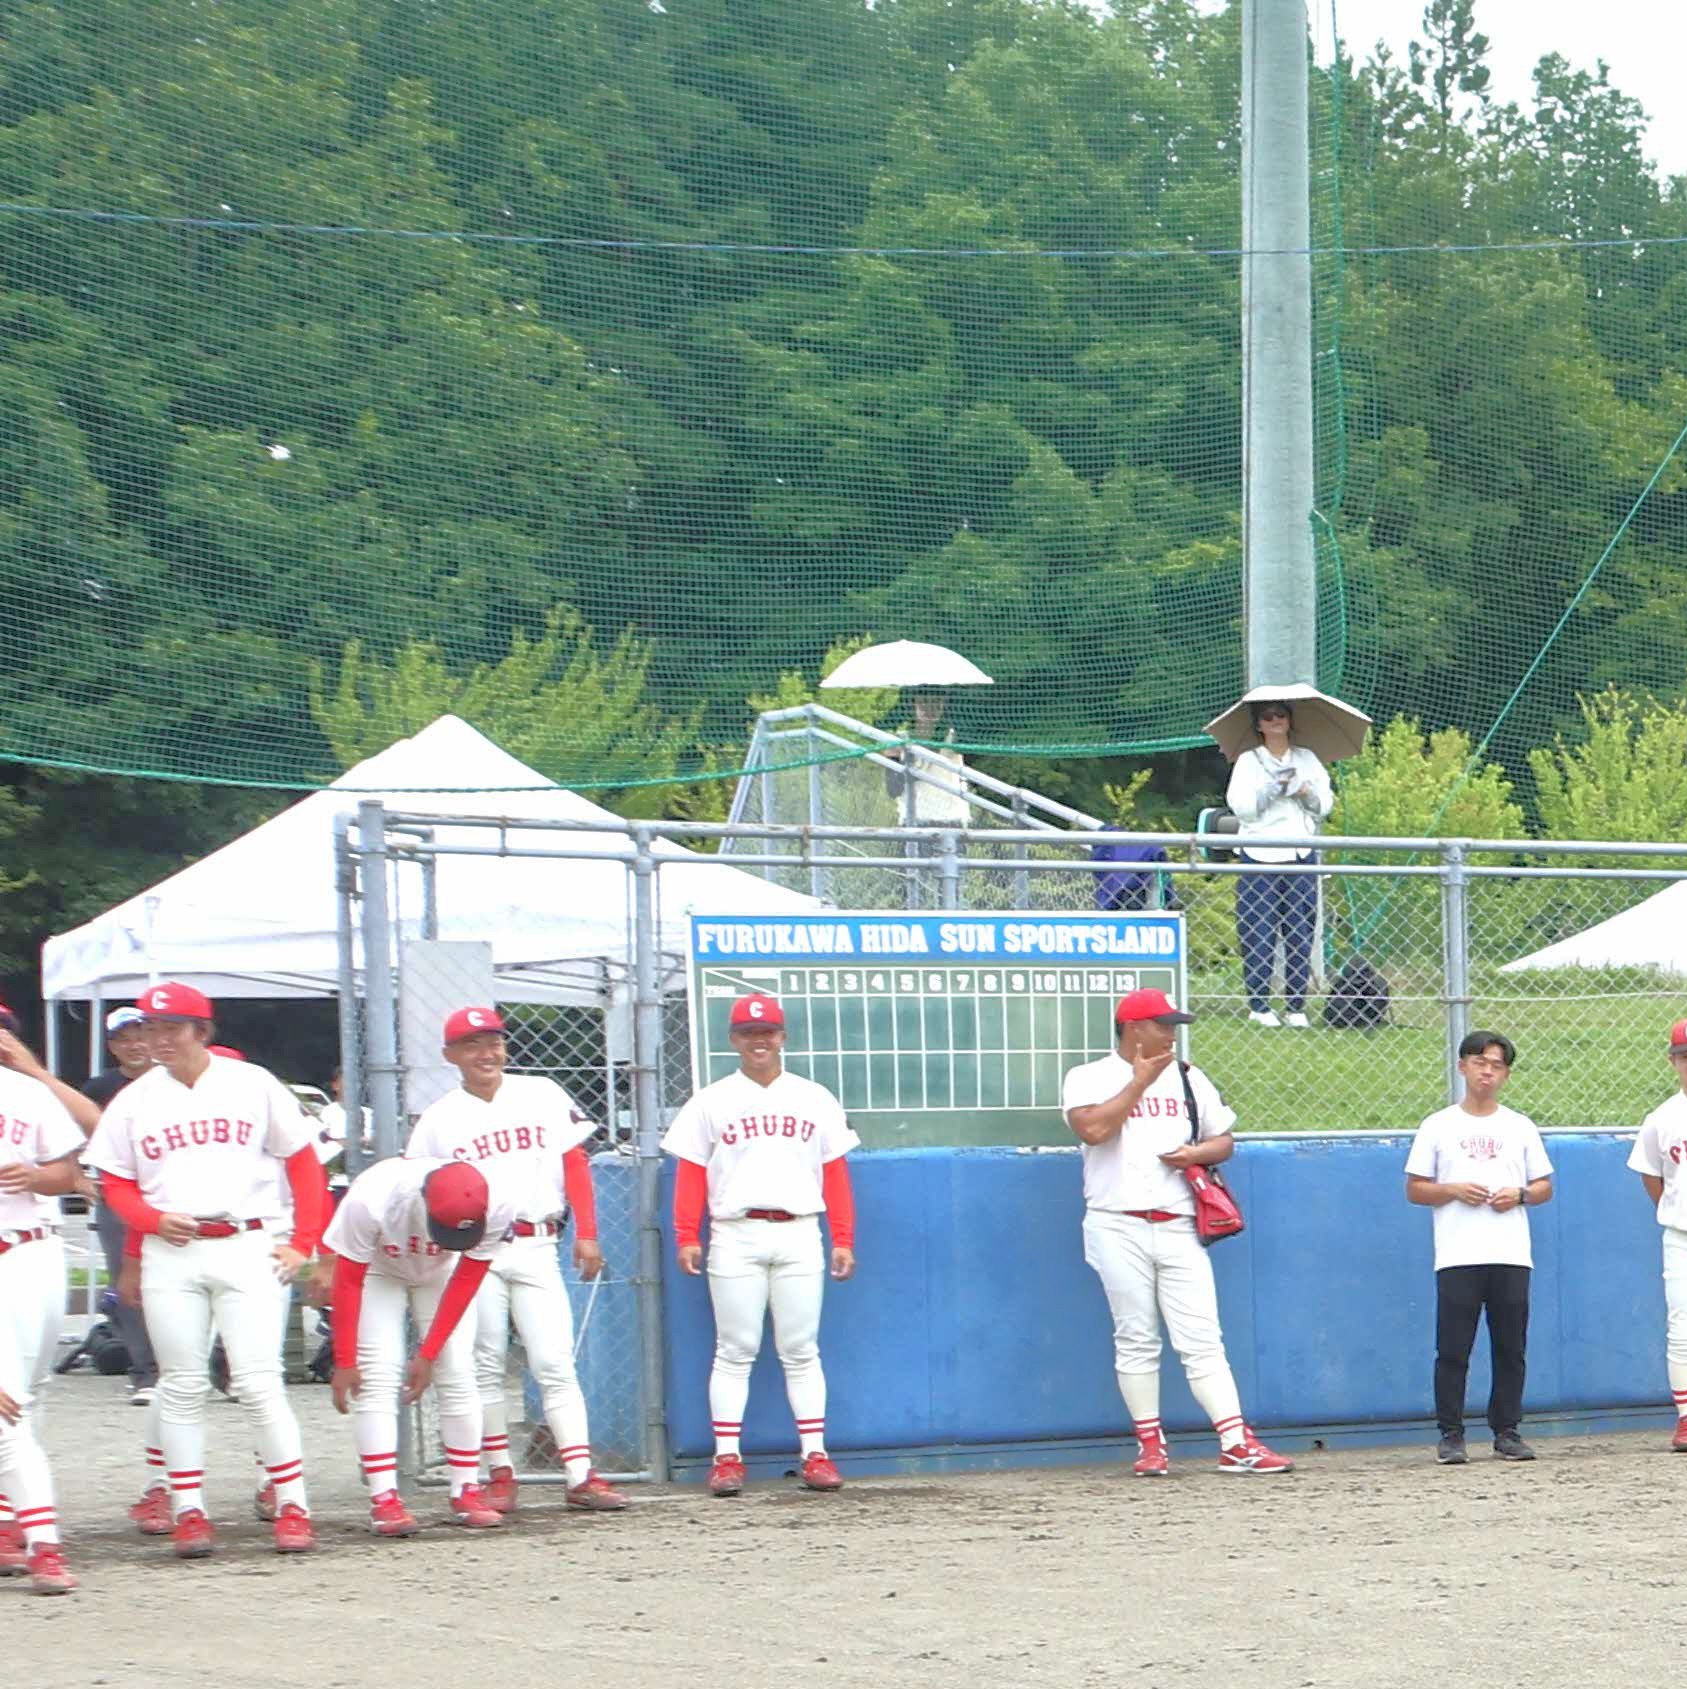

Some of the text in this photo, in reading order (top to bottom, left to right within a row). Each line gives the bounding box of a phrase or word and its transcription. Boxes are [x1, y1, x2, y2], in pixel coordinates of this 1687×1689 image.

[697, 923, 1176, 955] FURUKAWA HIDA SUN SPORTSLAND
[789, 974, 1136, 992] 1 2 3 4 5 6 7 8 9 10 11 12 13
